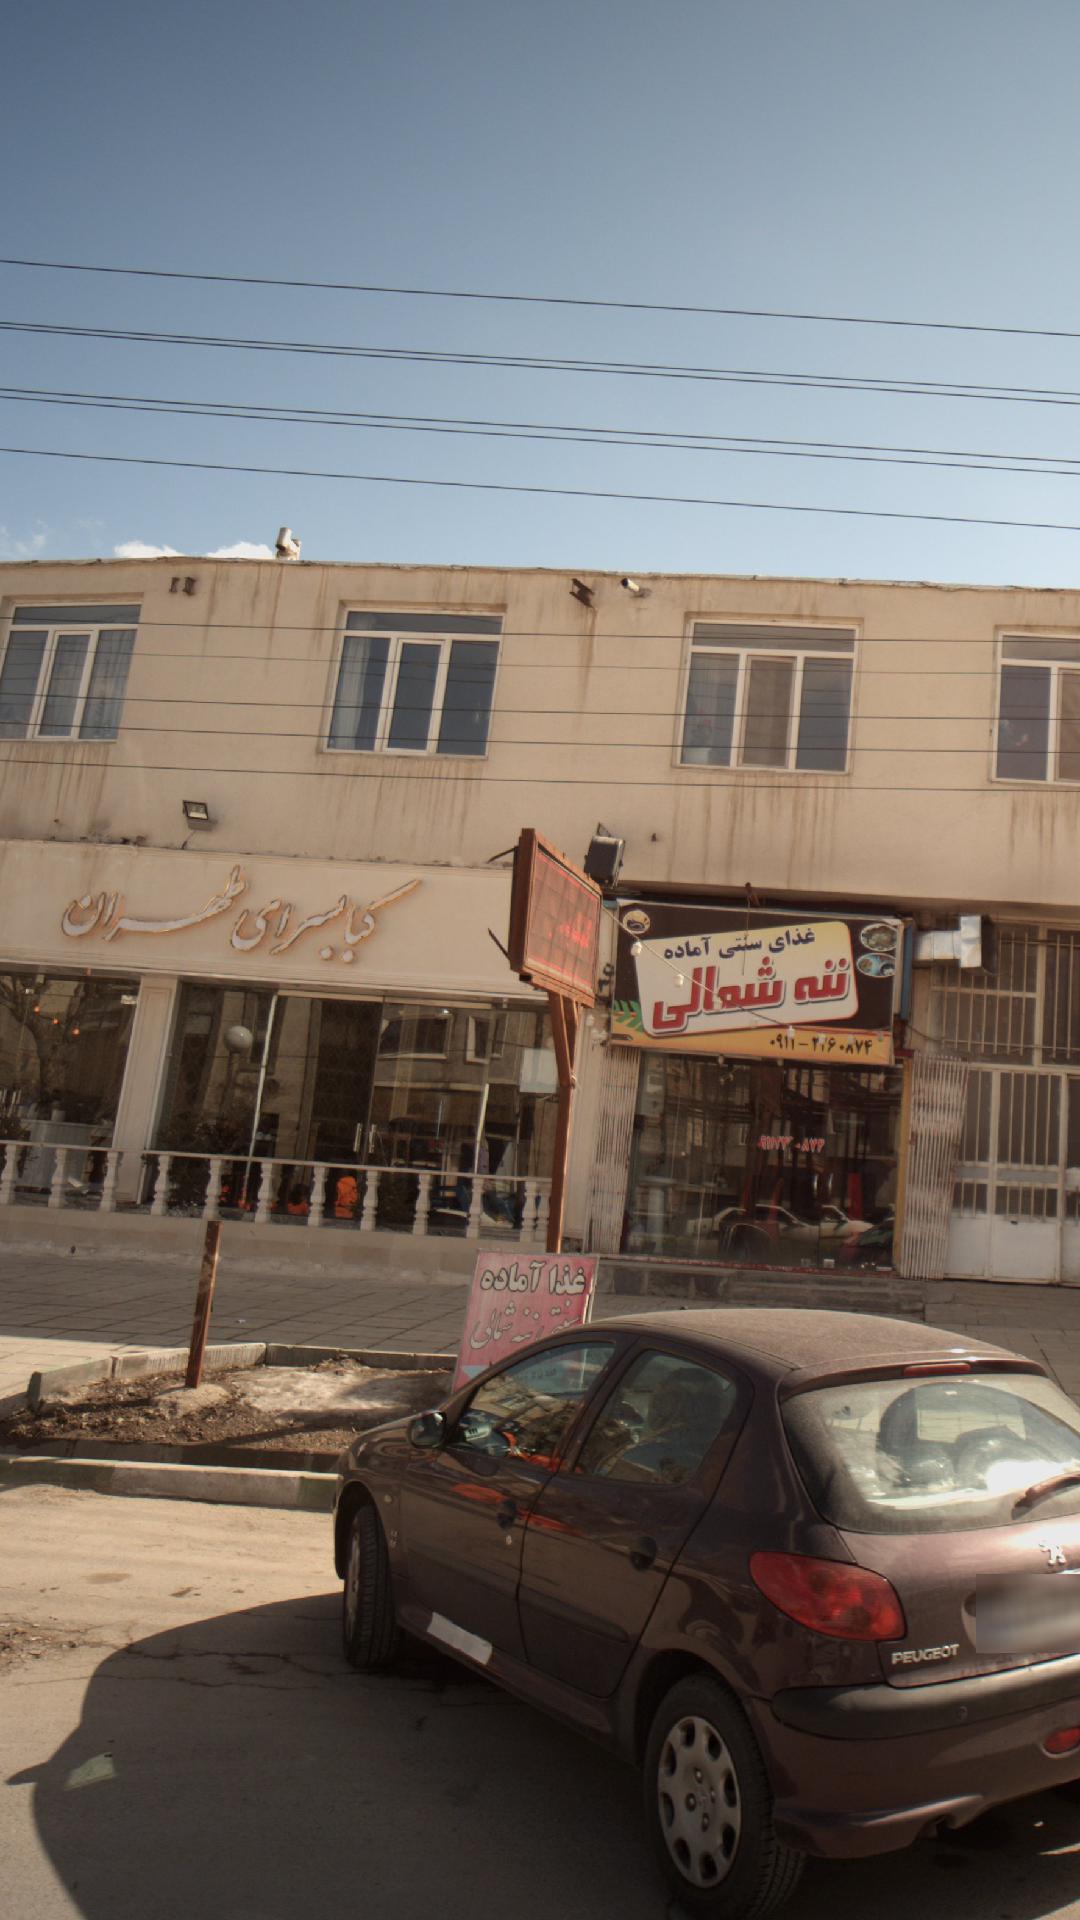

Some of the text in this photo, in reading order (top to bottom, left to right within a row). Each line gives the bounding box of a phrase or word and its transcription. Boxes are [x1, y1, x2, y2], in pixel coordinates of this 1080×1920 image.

[60, 862, 250, 943] طهران
[663, 926, 816, 960] غذای سنتی آماده
[651, 956, 784, 1031] شمالی
[793, 957, 850, 1002] ننه
[480, 1260, 587, 1295] غذا آماده
[470, 1301, 515, 1349] شمالی
[892, 1644, 960, 1664] PEUGEOT
